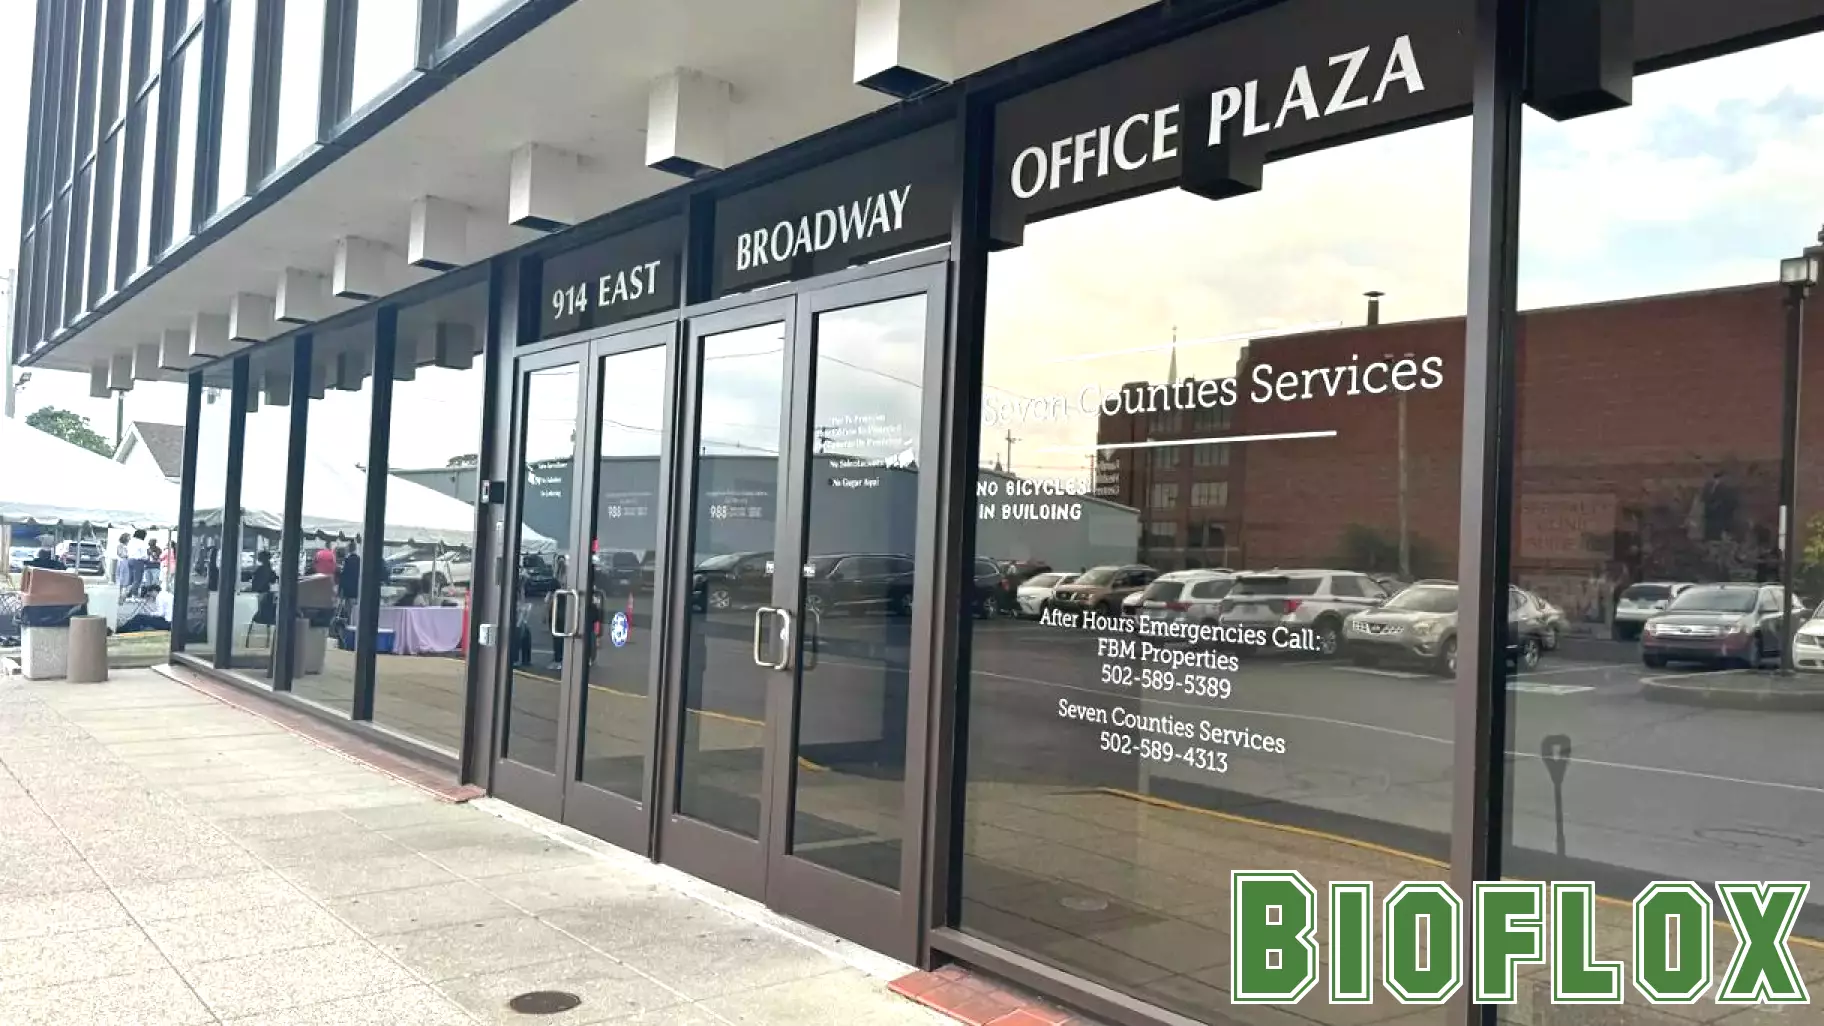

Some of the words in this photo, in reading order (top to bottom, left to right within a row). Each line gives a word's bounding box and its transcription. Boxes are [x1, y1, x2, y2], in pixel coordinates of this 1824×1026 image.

[1010, 104, 1180, 199] OFFICE
[1207, 35, 1425, 147] PLAZA
[737, 184, 912, 271] BROADWAY
[552, 282, 588, 320] 914
[598, 260, 660, 307] EAST
[983, 392, 1068, 427] Seven
[1078, 376, 1237, 417] Counties
[1250, 353, 1443, 402] Services
[976, 481, 999, 496] NO
[1006, 478, 1092, 496] BICYCLES
[979, 503, 995, 520] IN
[1002, 503, 1082, 520] BUILDING
[1039, 608, 1078, 628] After
[1083, 611, 1135, 633] Hours
[1139, 615, 1267, 647] Emergencies
[1272, 626, 1321, 651] Call:
[1098, 637, 1136, 660] FBM
[1141, 643, 1239, 672] Properties
[1101, 664, 1231, 699] 502-589-5389
[1058, 699, 1107, 724] Seven
[1112, 707, 1195, 739] Counties
[1199, 720, 1286, 754] Services
[1100, 731, 1229, 773] 502-589-4313
